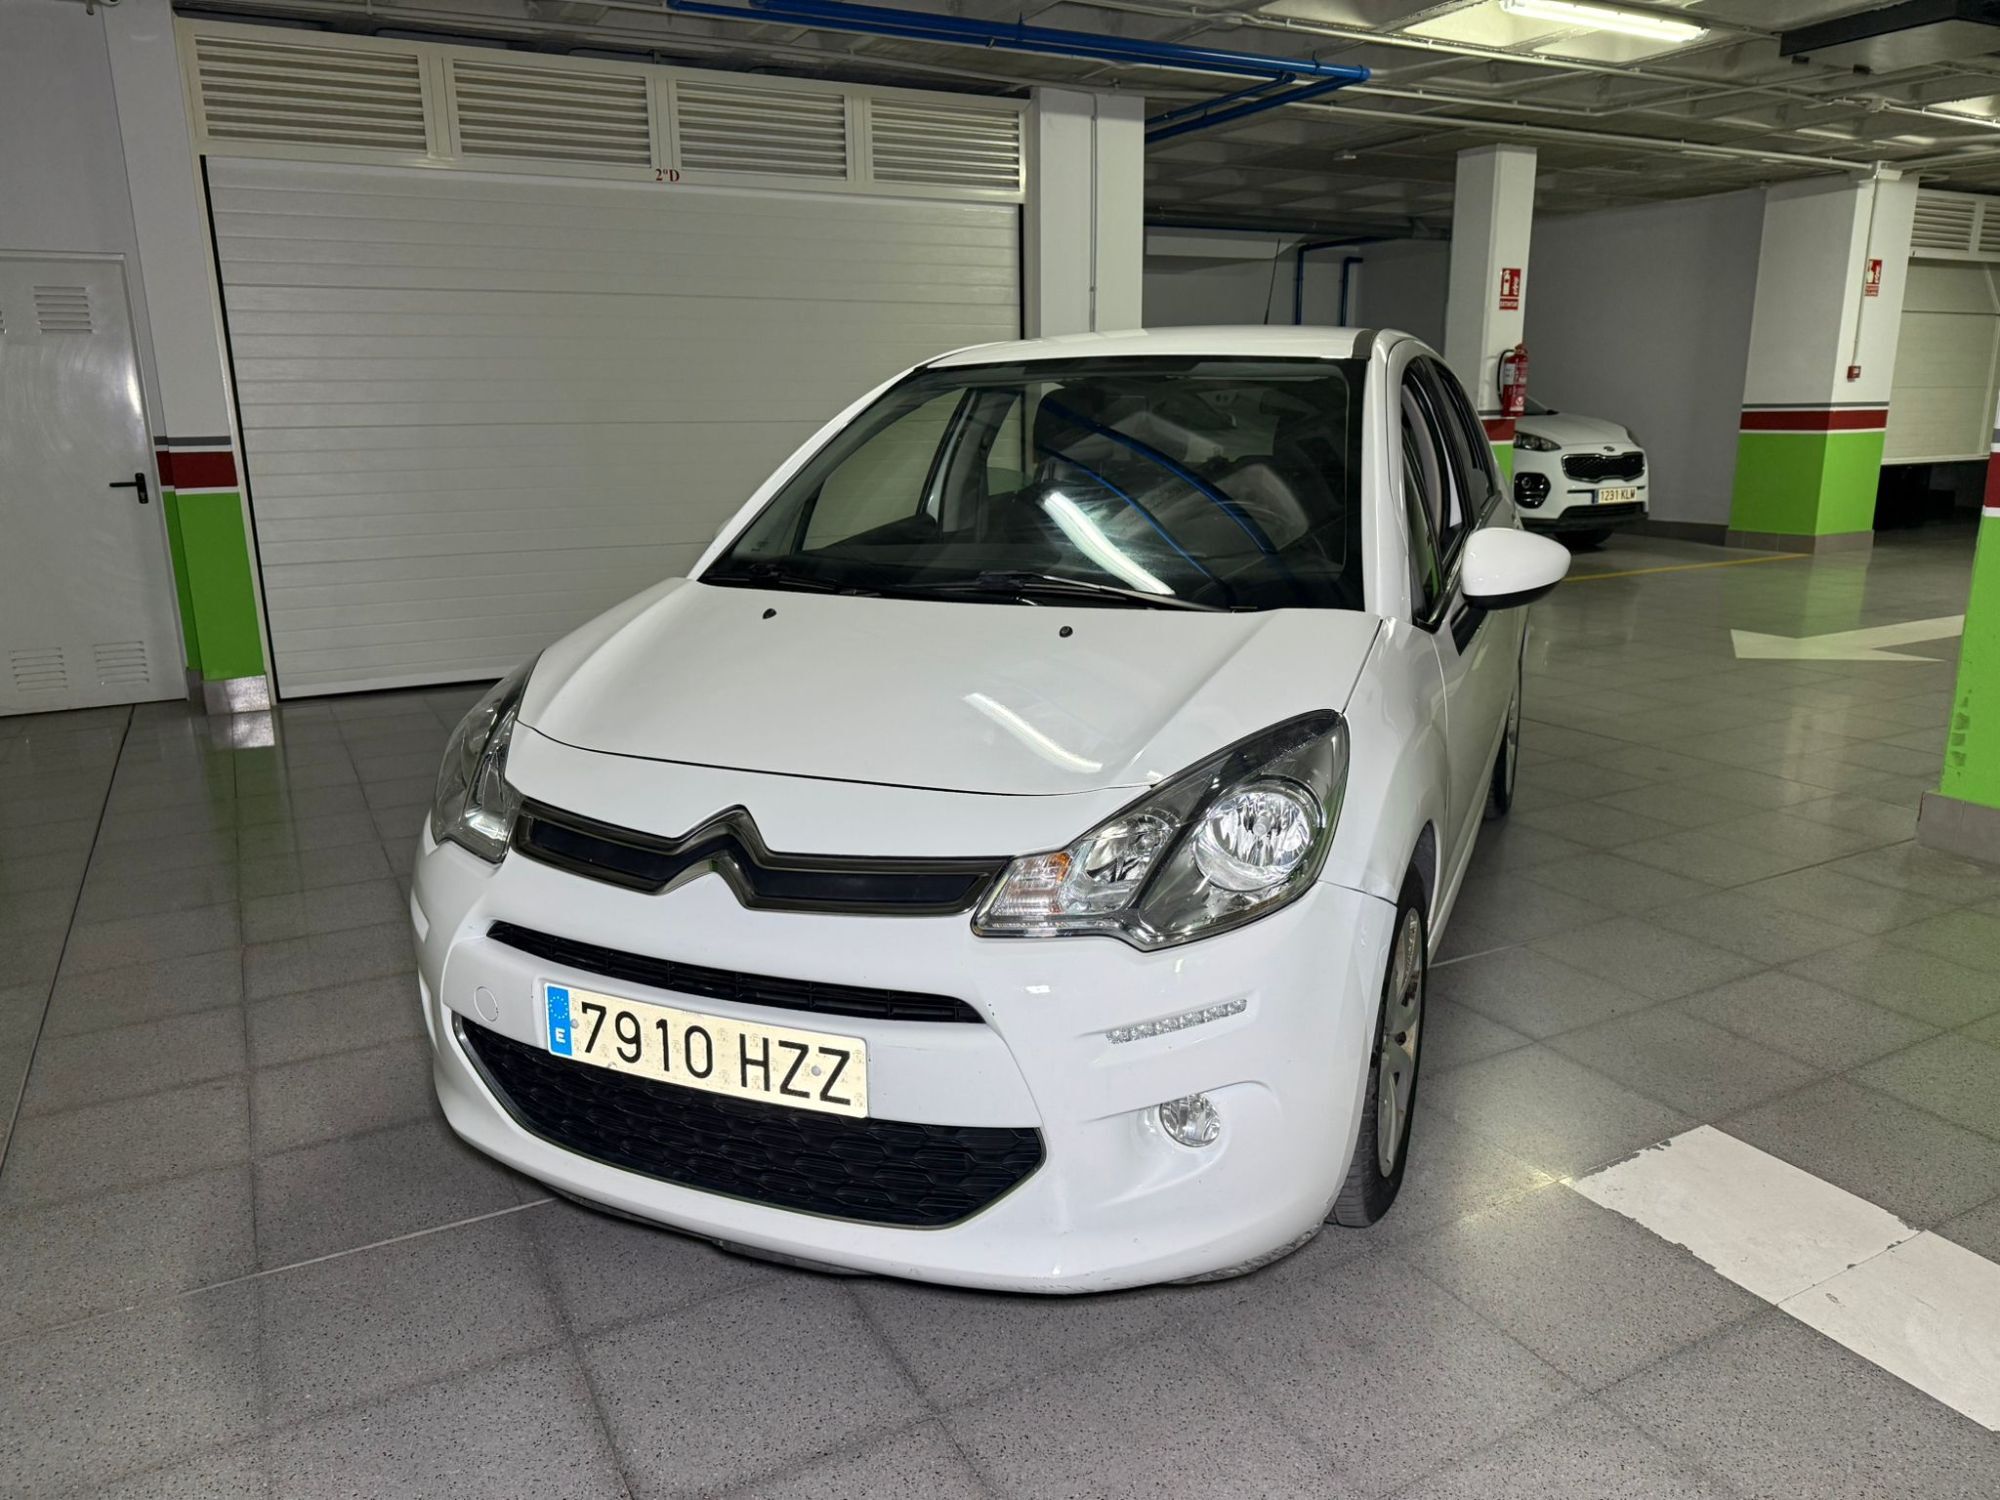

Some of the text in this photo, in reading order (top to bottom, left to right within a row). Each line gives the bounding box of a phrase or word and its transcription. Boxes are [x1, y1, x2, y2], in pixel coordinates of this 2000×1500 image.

[1601, 490, 1619, 501] 1231
[555, 1027, 566, 1044] E
[581, 1001, 851, 1106] 7910 HZZ
